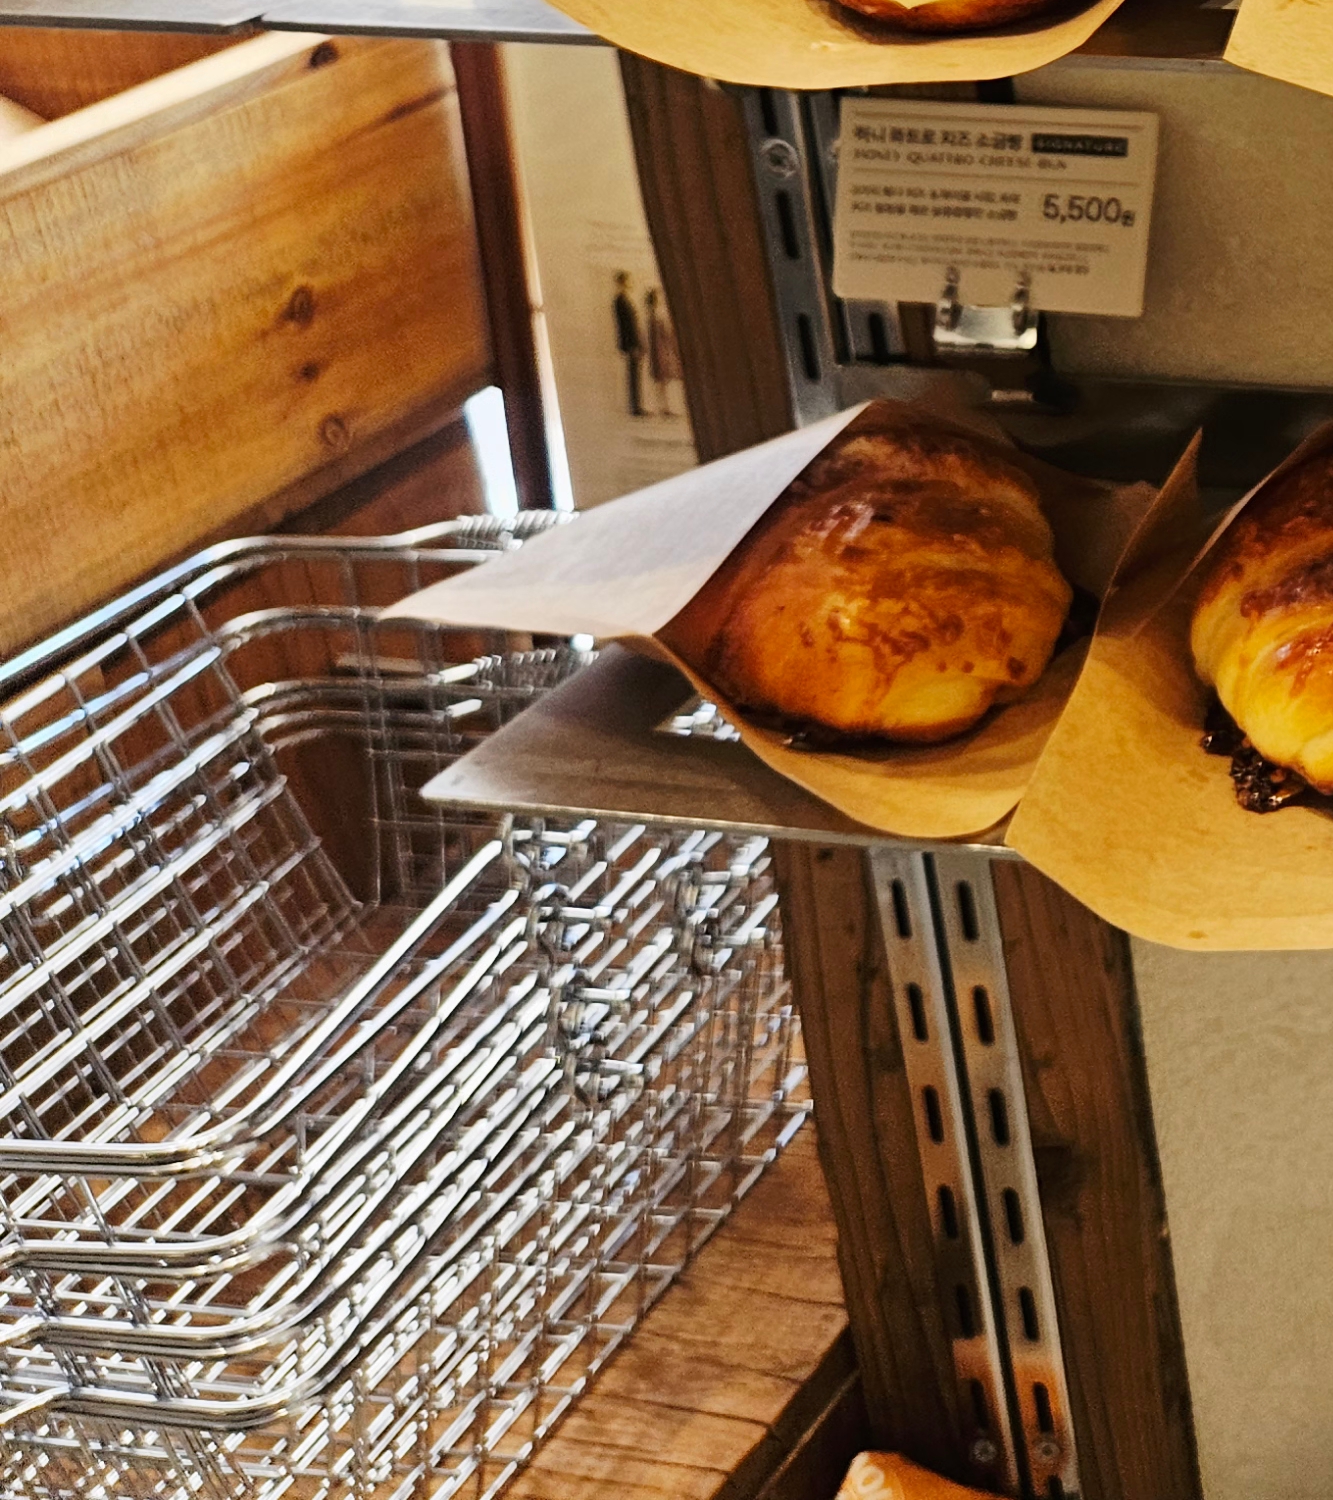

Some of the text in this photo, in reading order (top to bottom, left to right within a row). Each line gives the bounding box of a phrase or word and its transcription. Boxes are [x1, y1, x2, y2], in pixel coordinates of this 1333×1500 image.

[941, 130, 972, 148] 치즈
[976, 131, 1023, 151] 소금빵
[854, 148, 1067, 171] HONEY QUATTRO CHEESE BUN
